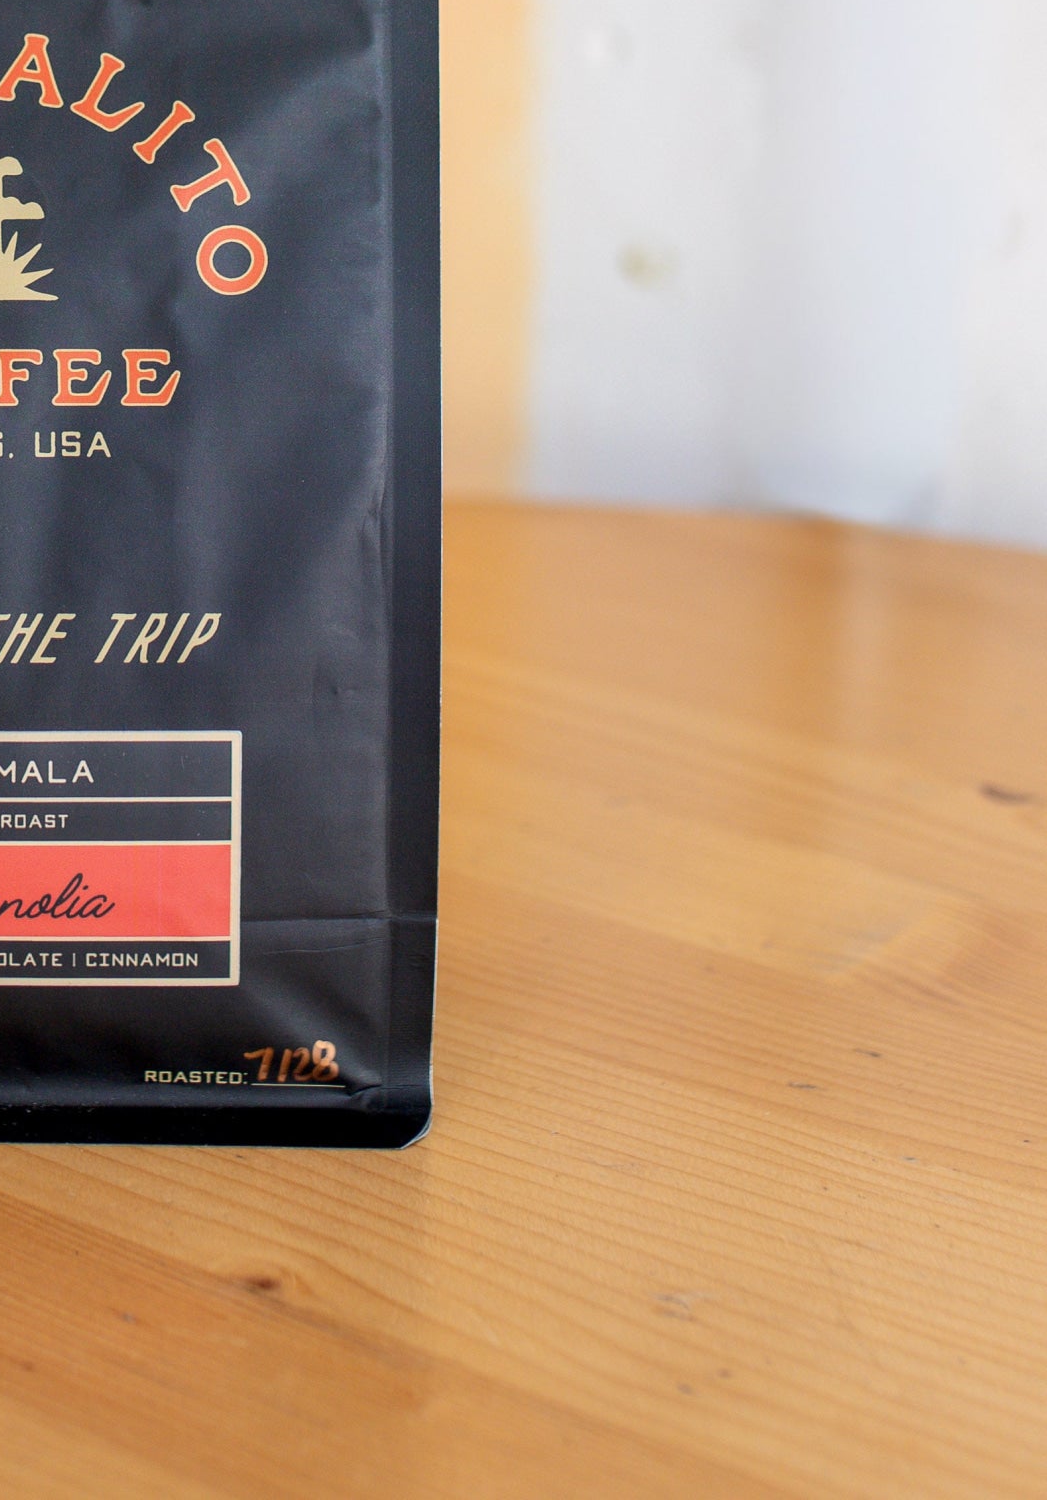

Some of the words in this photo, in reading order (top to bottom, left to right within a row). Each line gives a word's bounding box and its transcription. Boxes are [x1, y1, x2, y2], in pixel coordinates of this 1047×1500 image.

[34, 431, 112, 458] USA
[94, 613, 222, 664] TRIP
[0, 813, 69, 830] ROAST
[85, 952, 199, 967] CINNAMON
[144, 1070, 248, 1085] ROASTED:
